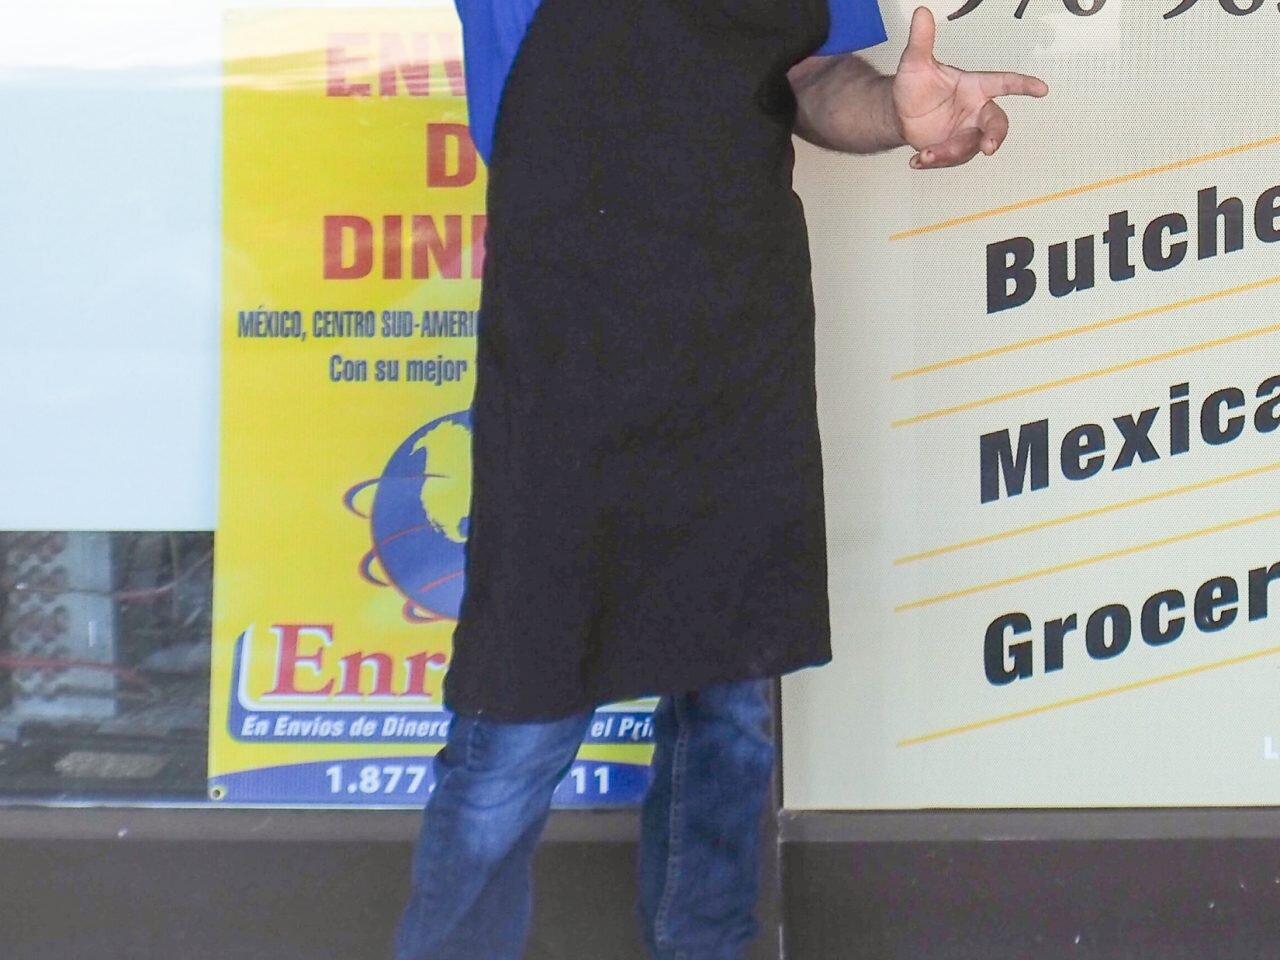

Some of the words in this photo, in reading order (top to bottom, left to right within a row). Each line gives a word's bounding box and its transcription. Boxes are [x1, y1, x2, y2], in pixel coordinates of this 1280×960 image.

[237, 304, 307, 342] MÉXICO,
[312, 310, 376, 338] CENTRO
[329, 354, 367, 382] Con
[374, 359, 399, 382] su
[405, 354, 468, 386] mejor
[241, 714, 271, 737] En
[350, 715, 378, 737] de
[590, 716, 614, 738] el
